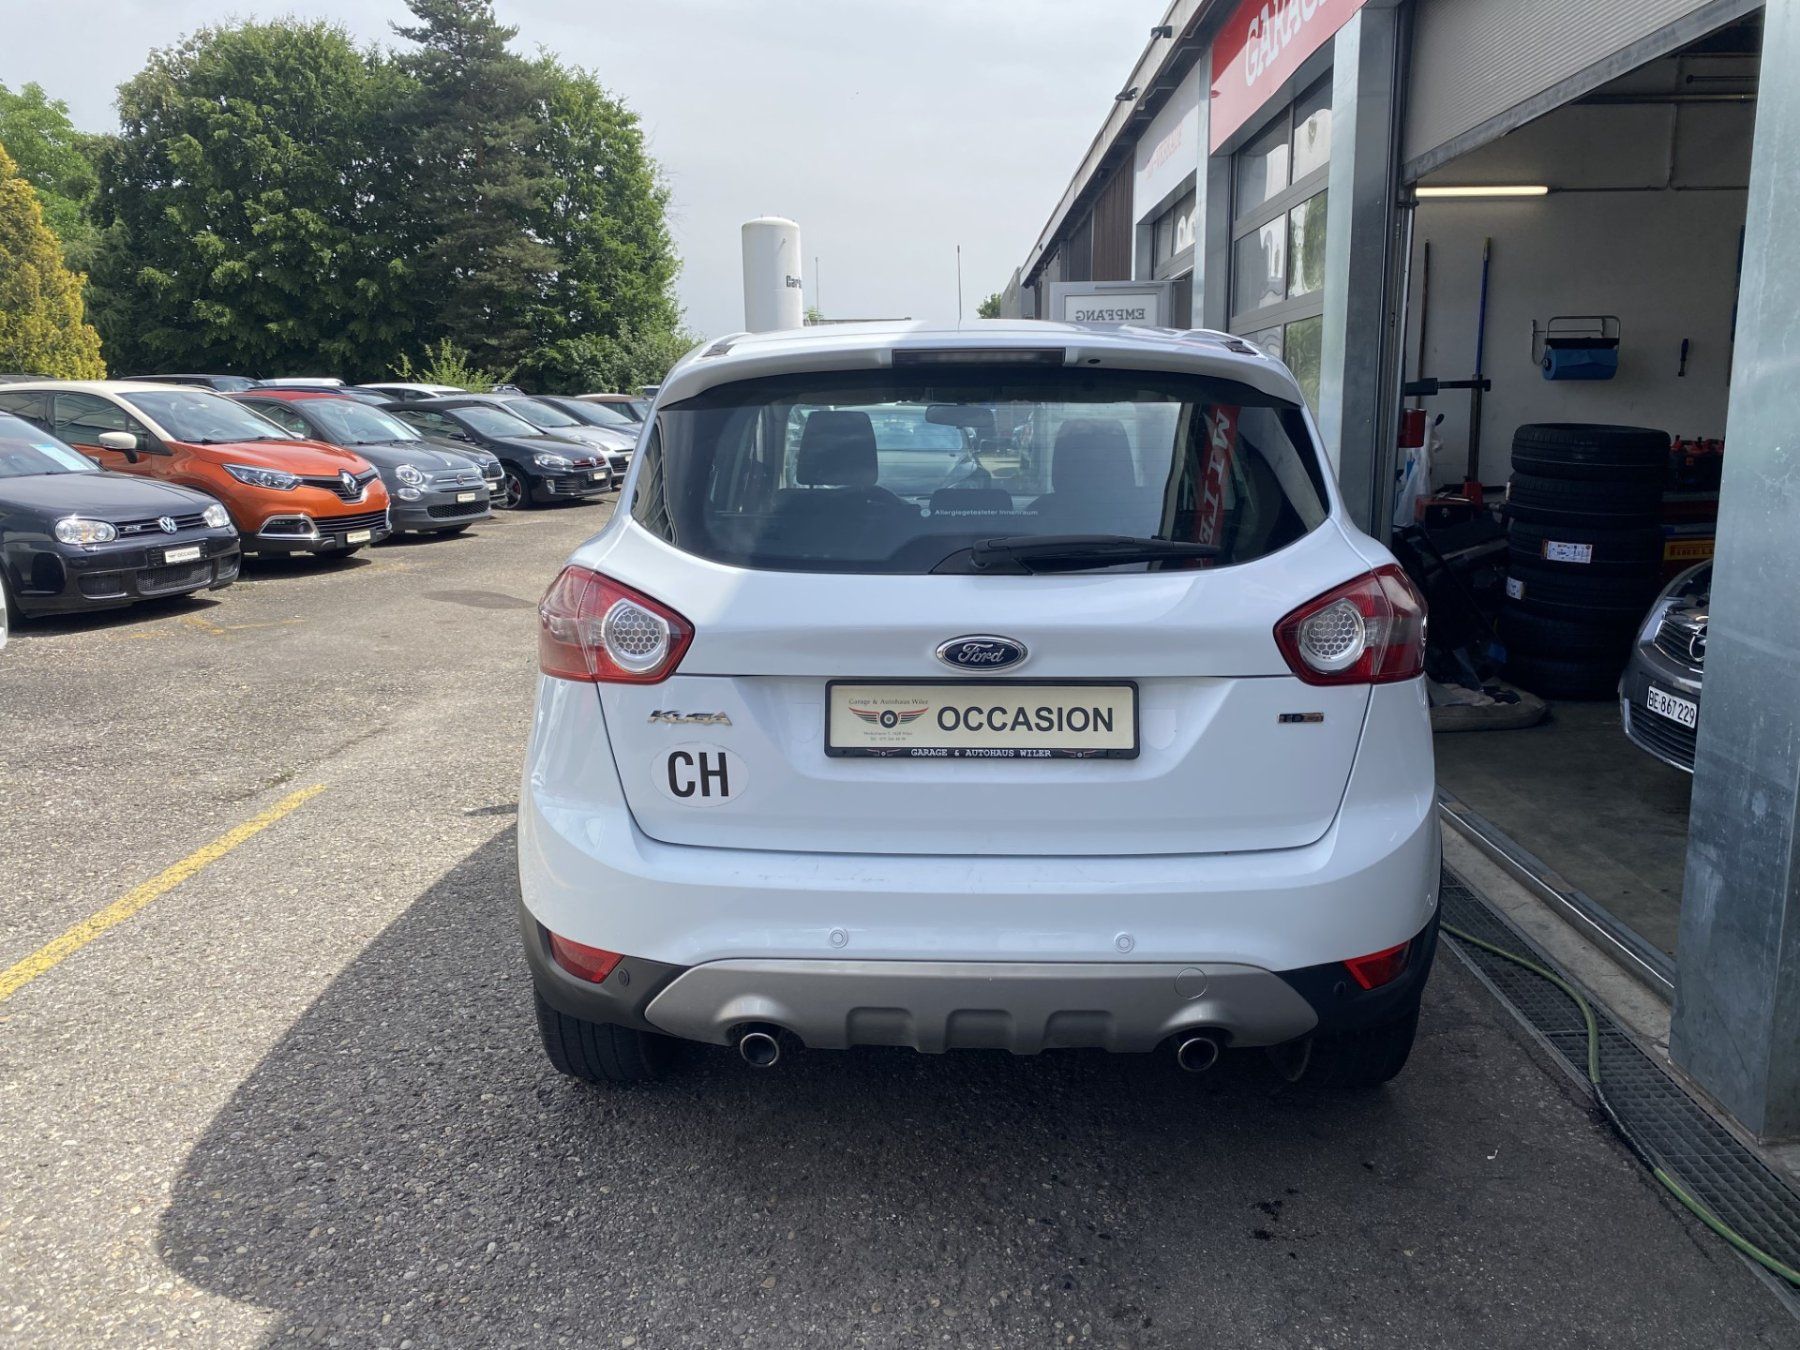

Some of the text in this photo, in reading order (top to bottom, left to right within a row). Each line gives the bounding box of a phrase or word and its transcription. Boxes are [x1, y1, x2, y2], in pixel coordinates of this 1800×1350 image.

[957, 642, 1005, 662] Ford
[936, 706, 1113, 732] OCCASION
[911, 748, 1052, 758] GARAGE & AUTOHAUS WILER
[668, 751, 729, 798] CH
